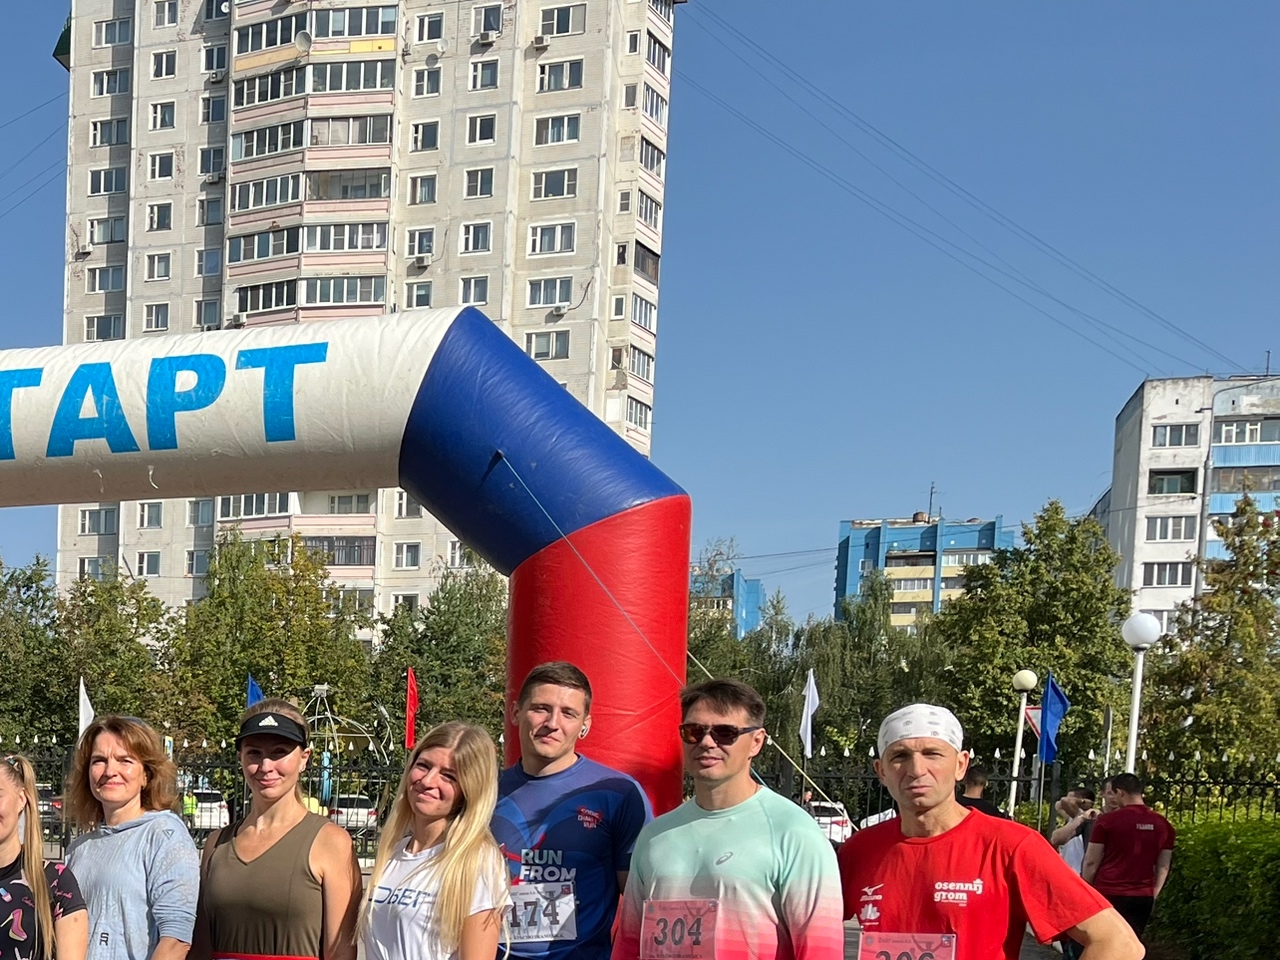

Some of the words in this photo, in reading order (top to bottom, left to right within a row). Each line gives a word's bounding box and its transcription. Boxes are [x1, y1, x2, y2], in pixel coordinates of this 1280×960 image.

[521, 848, 562, 865] RUN
[519, 865, 576, 881] FROM
[933, 891, 968, 902] grom
[510, 900, 560, 928] 174
[653, 917, 702, 946] 304
